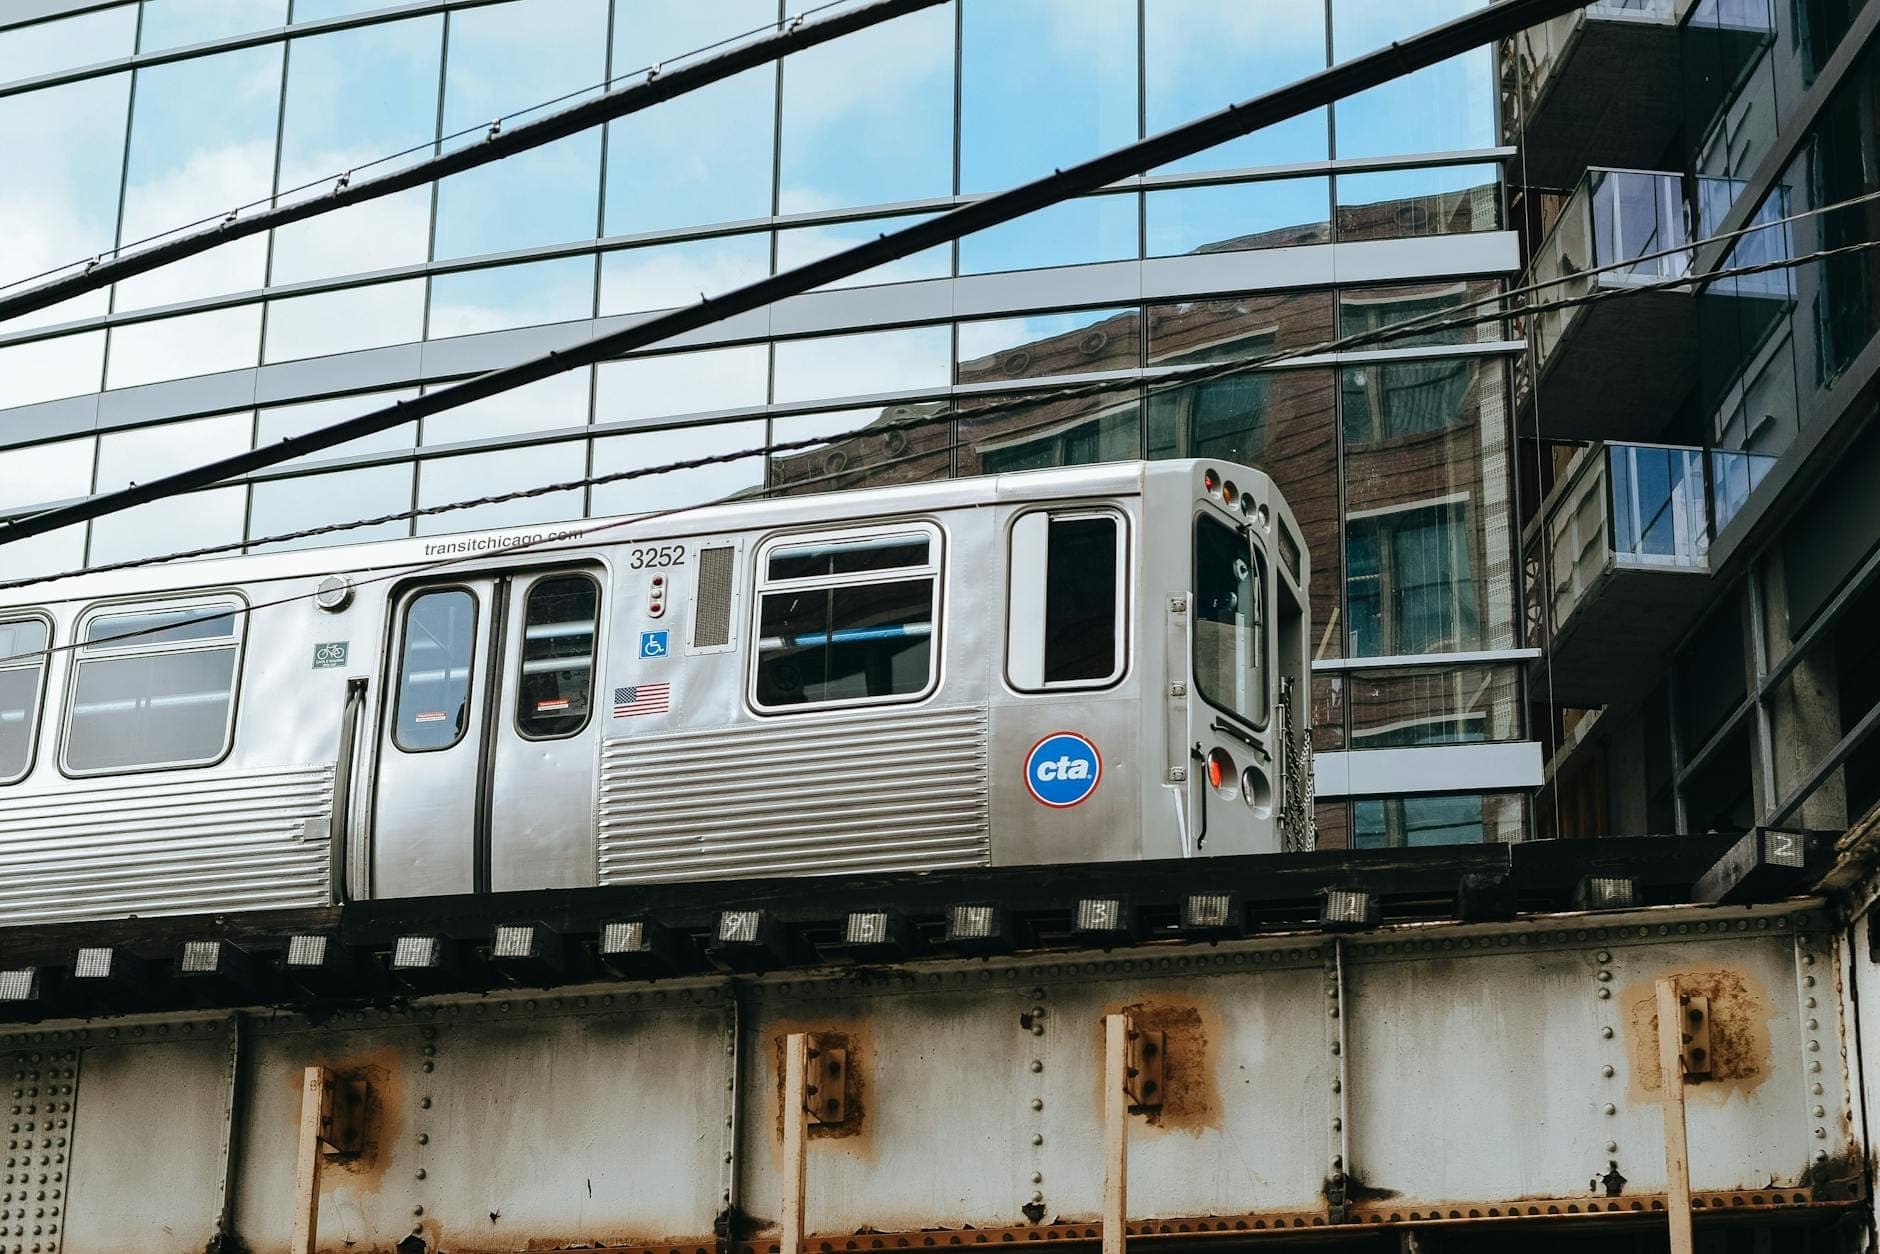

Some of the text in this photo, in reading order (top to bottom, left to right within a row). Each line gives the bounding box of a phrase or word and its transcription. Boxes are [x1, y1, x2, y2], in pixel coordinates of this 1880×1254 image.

[425, 528, 583, 556] transitchicago.com
[630, 545, 685, 570] 3252
[1036, 755, 1089, 782] cta
[1772, 836, 1796, 857] 2
[862, 914, 878, 937] 5
[1091, 904, 1107, 923] 3
